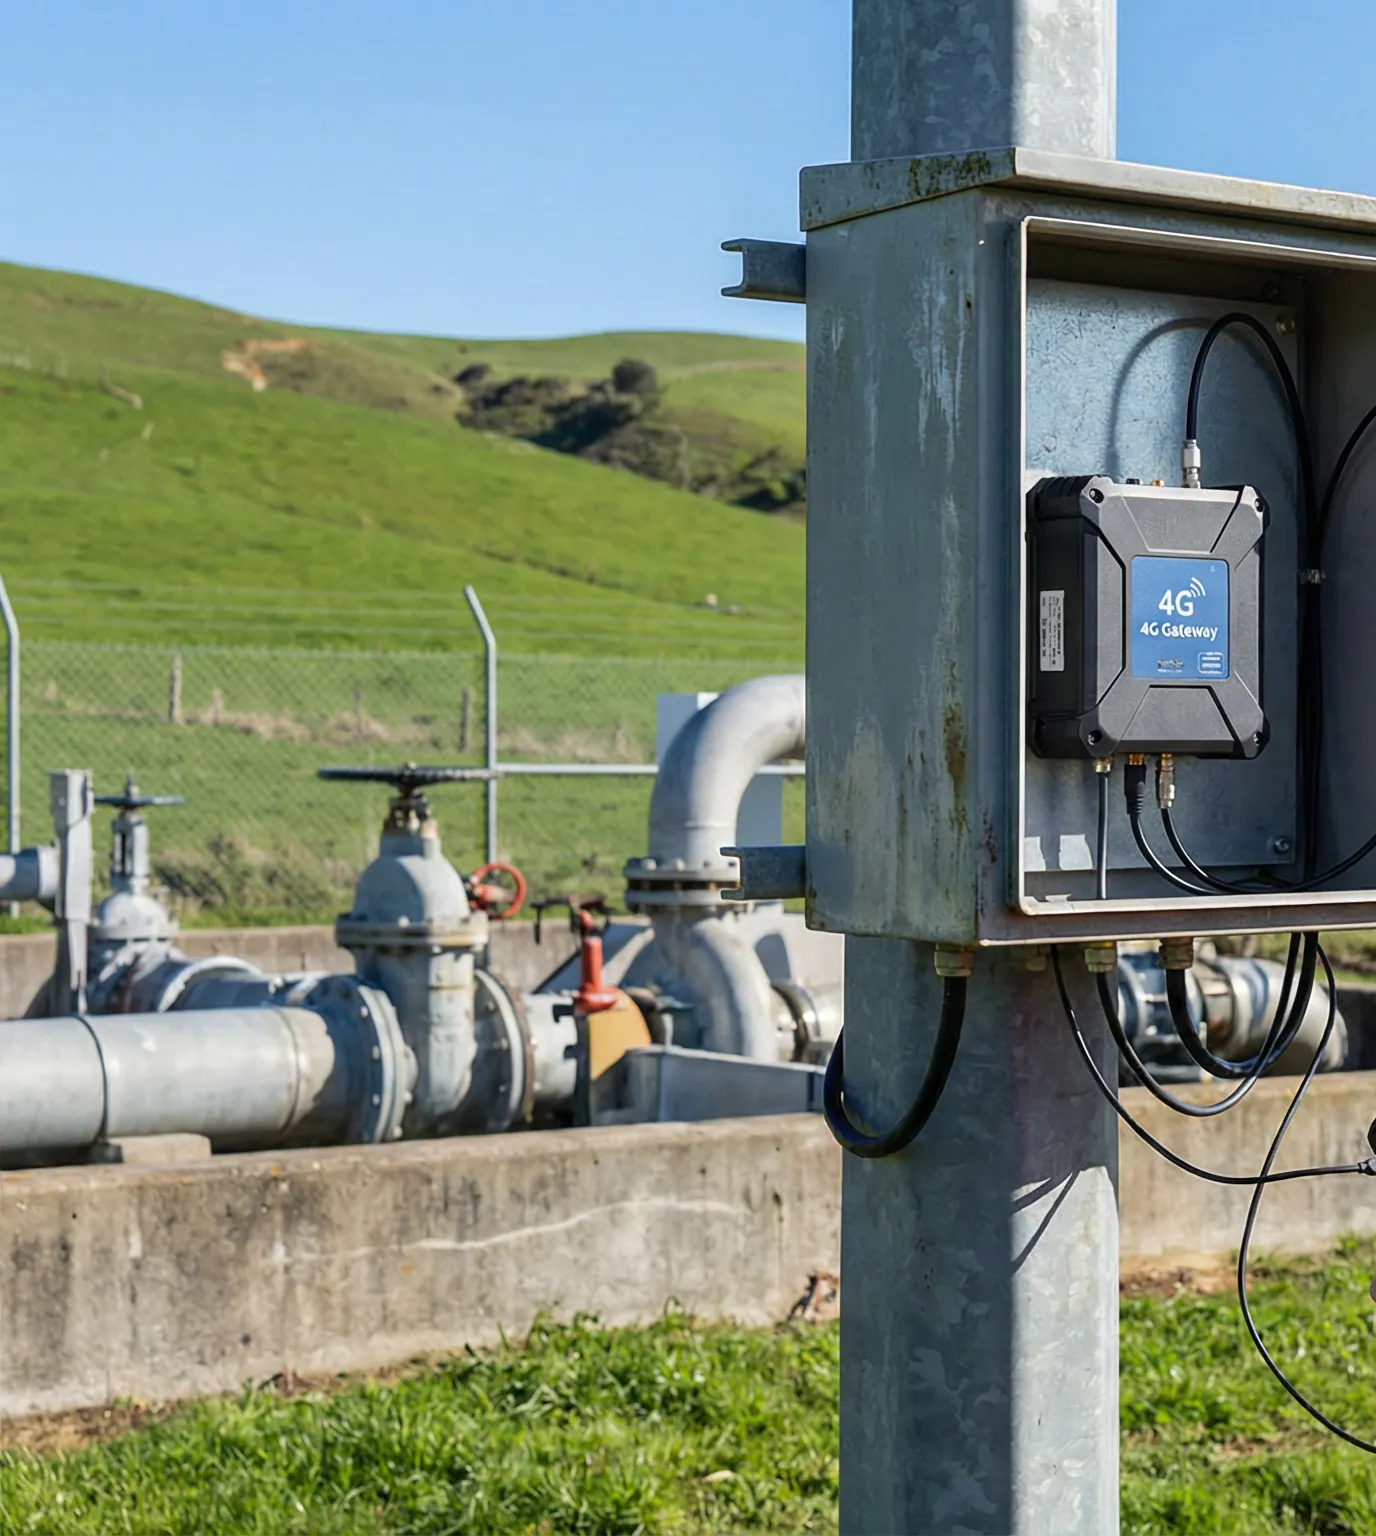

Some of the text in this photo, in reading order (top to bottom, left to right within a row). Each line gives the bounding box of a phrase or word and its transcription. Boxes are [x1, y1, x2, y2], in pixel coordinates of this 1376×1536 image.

[1158, 589, 1195, 617] 4G
[1140, 621, 1219, 642] 4G Gateway
